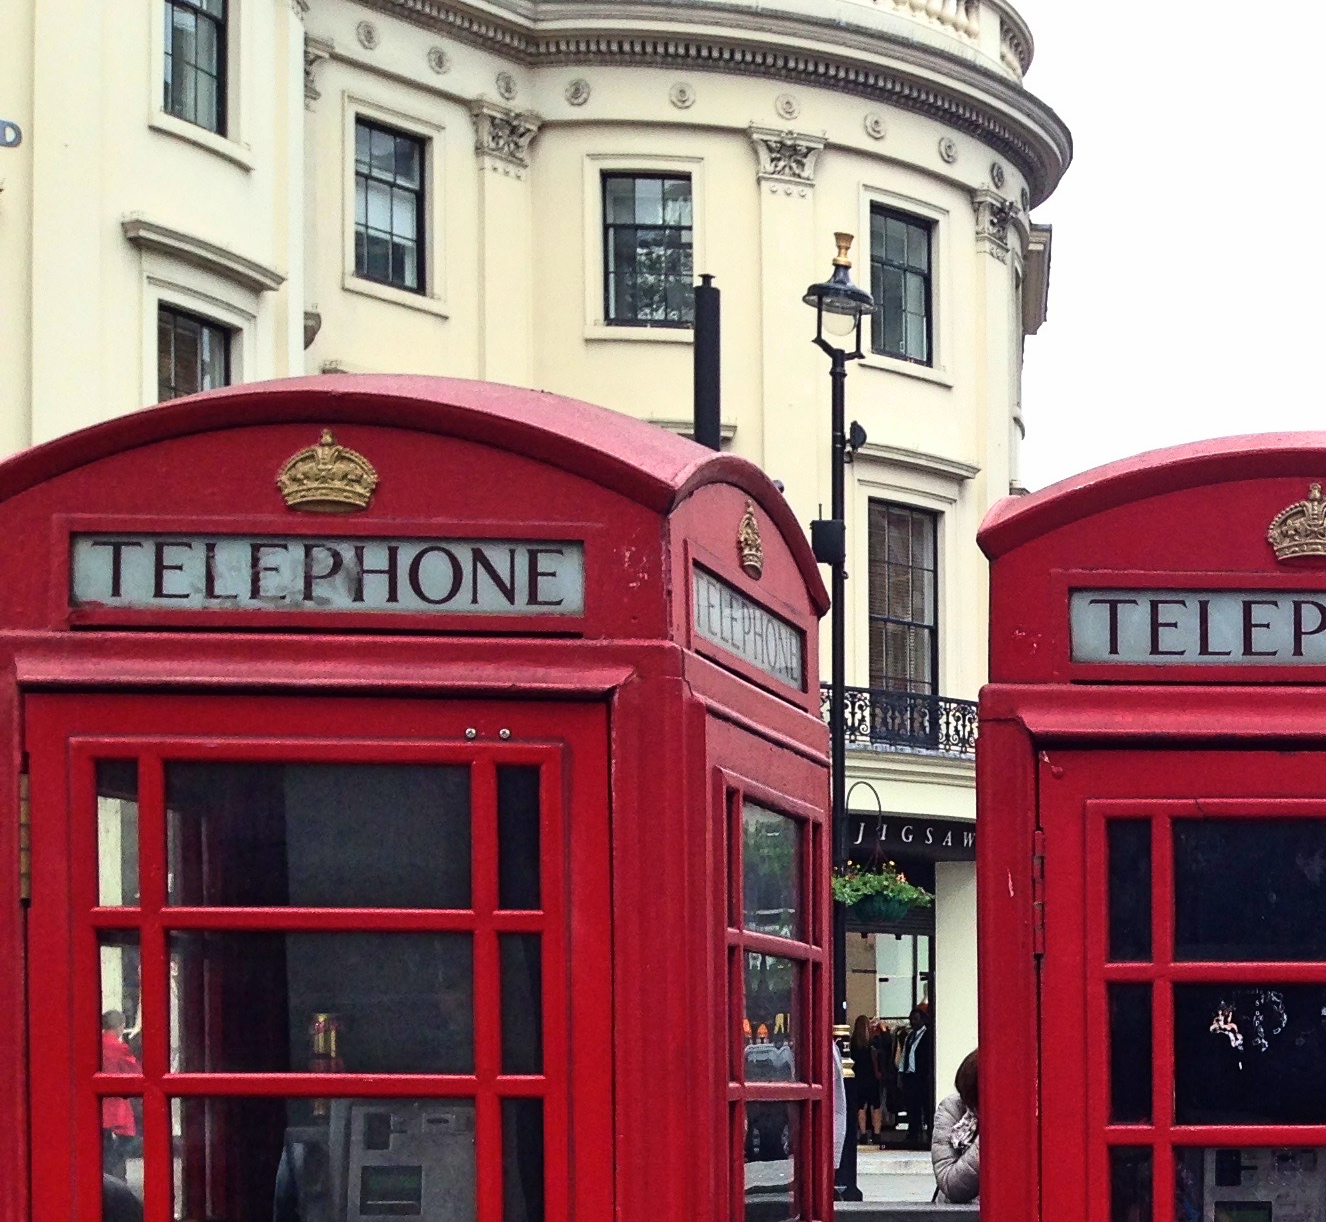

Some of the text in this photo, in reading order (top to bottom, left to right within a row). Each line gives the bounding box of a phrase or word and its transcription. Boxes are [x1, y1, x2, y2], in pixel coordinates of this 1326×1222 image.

[91, 540, 565, 606] TELEPHONE
[694, 576, 799, 683] TELEPHONE
[853, 822, 976, 847] JIGSAW
